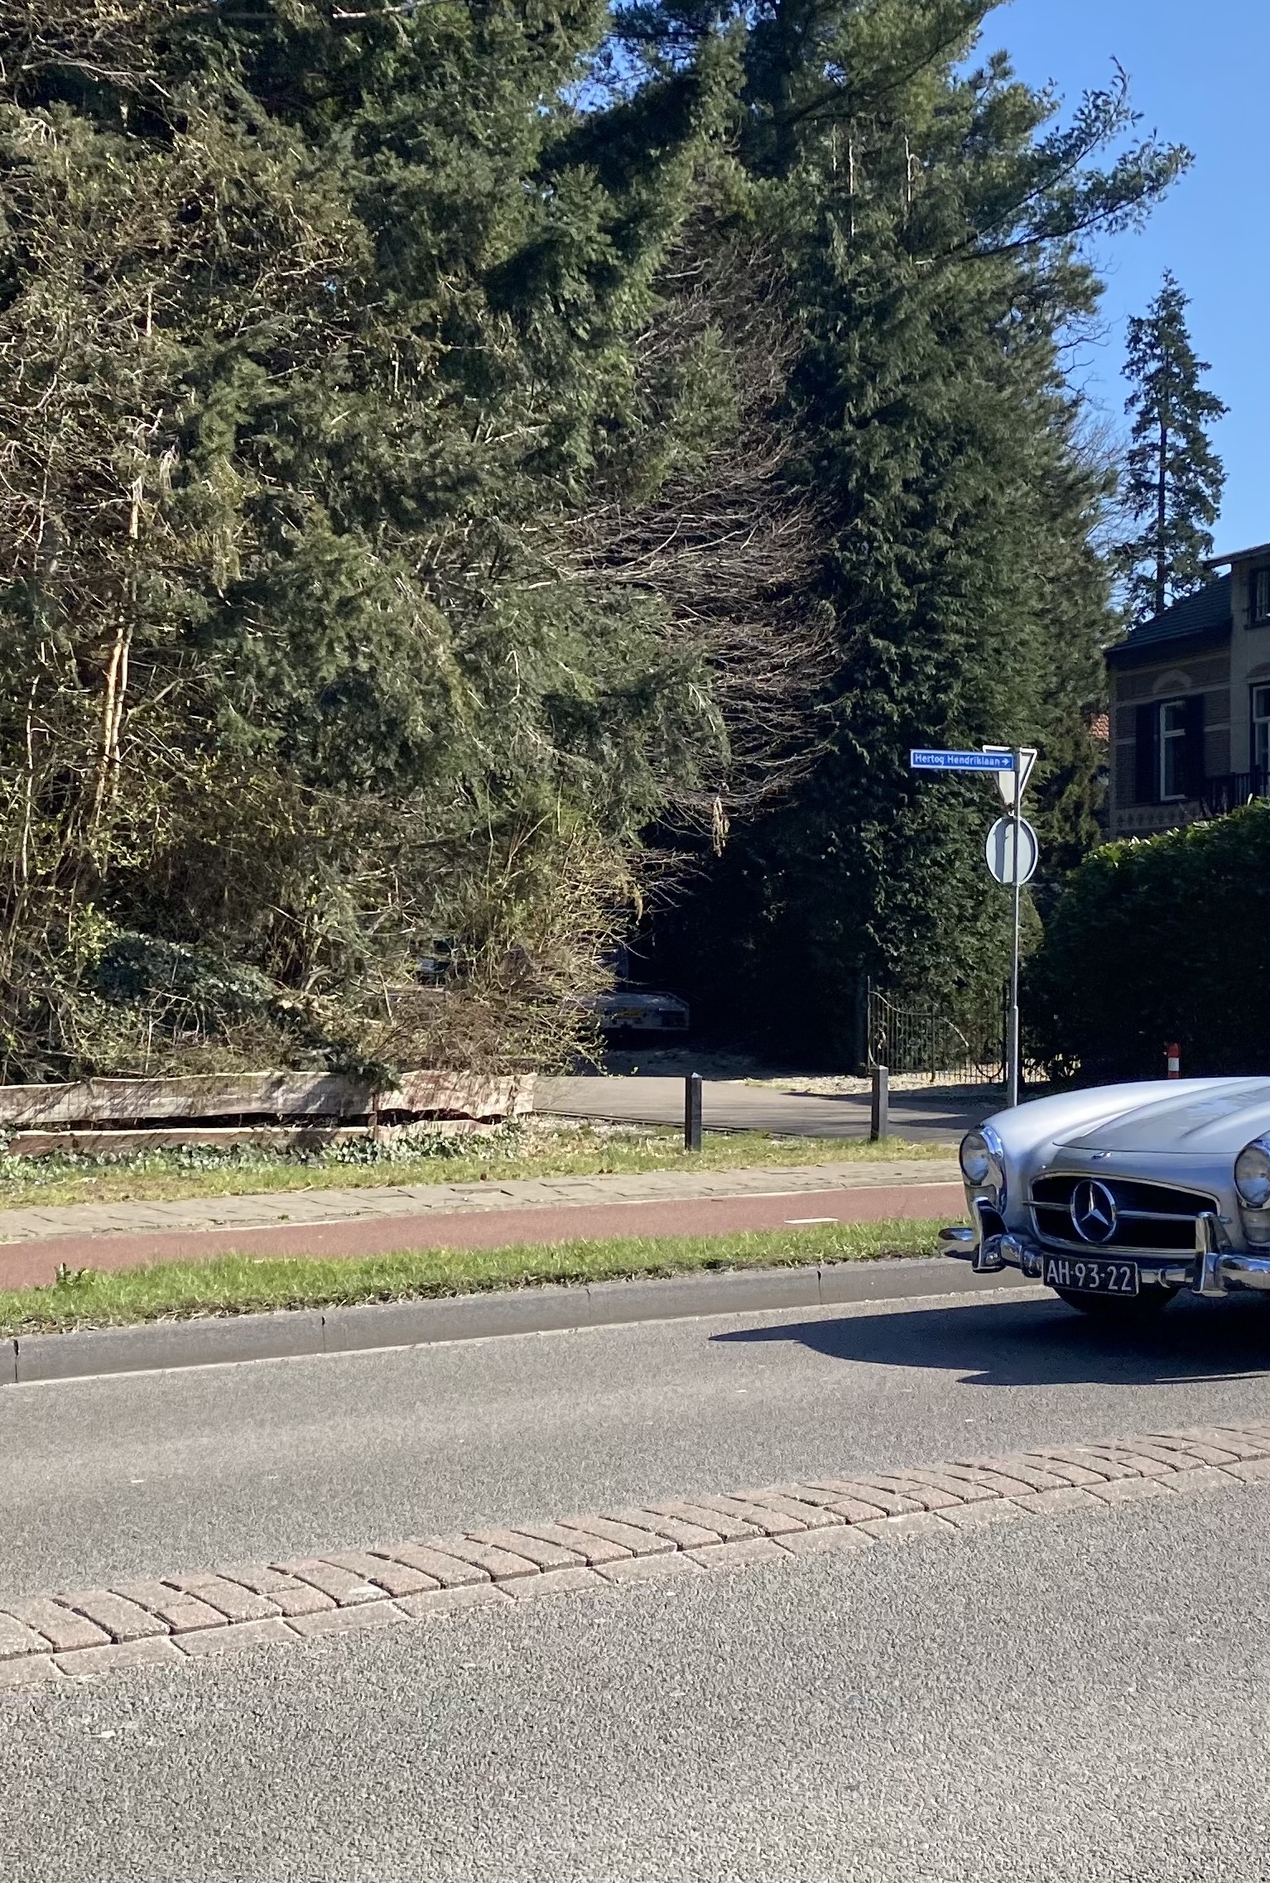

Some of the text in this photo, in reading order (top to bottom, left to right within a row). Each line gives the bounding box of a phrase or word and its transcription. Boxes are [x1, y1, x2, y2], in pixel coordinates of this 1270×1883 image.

[915, 754, 1001, 766] Hertog Hendriklaan
[1047, 1260, 1132, 1291] AH-93-22
